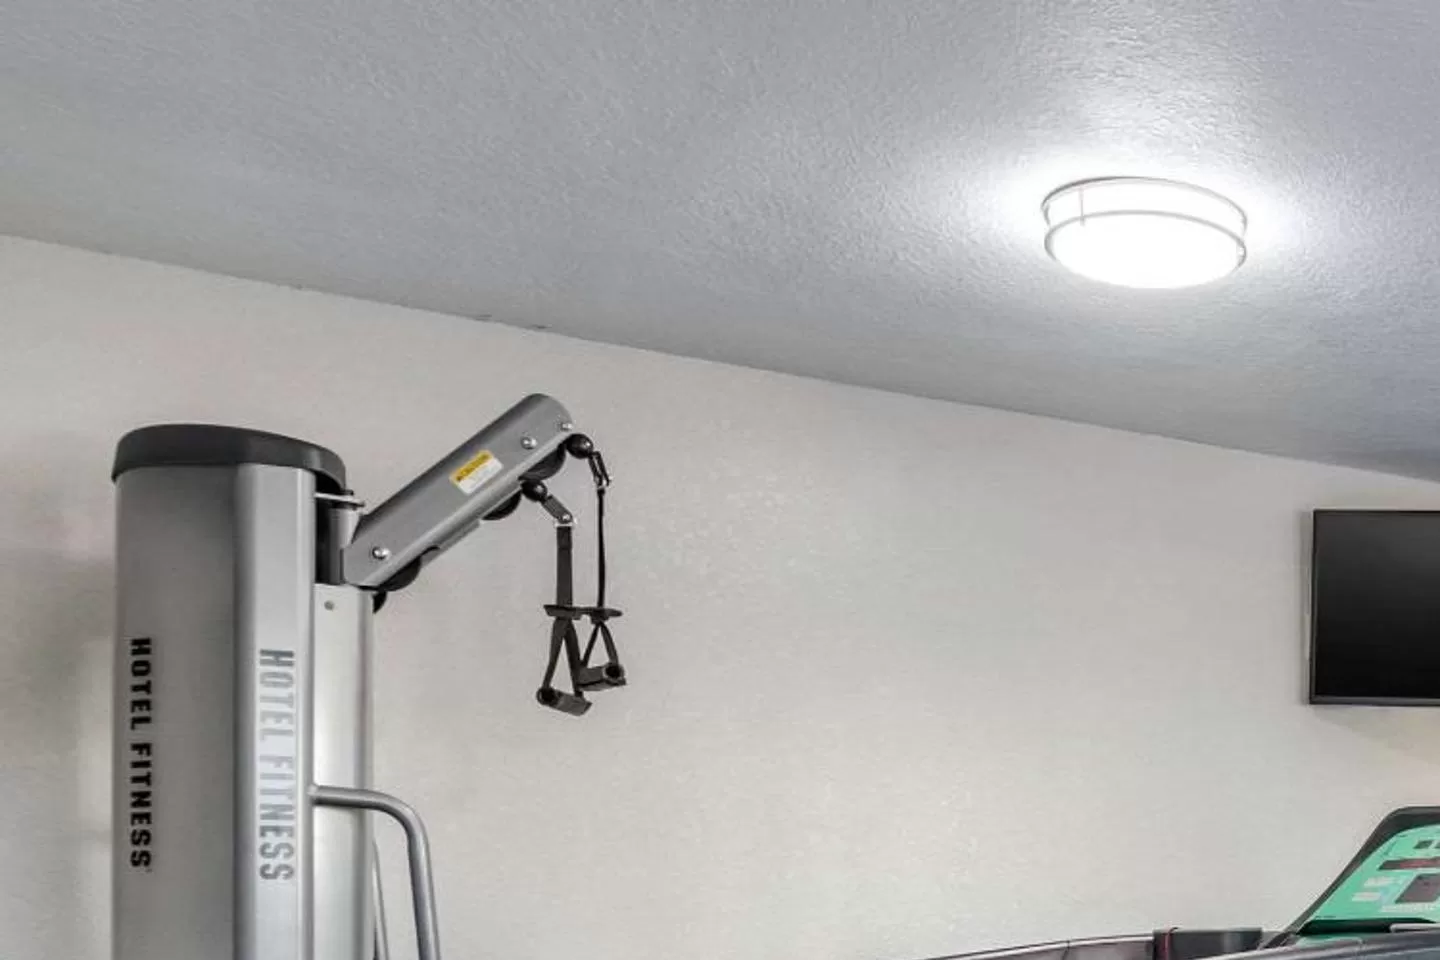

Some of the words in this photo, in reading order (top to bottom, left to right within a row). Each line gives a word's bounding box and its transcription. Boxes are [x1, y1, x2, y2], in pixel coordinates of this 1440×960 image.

[131, 637, 151, 730] HOTEL
[260, 649, 294, 740] HOTEL
[131, 743, 152, 868] FITNESS
[260, 755, 294, 880] FITNESS
